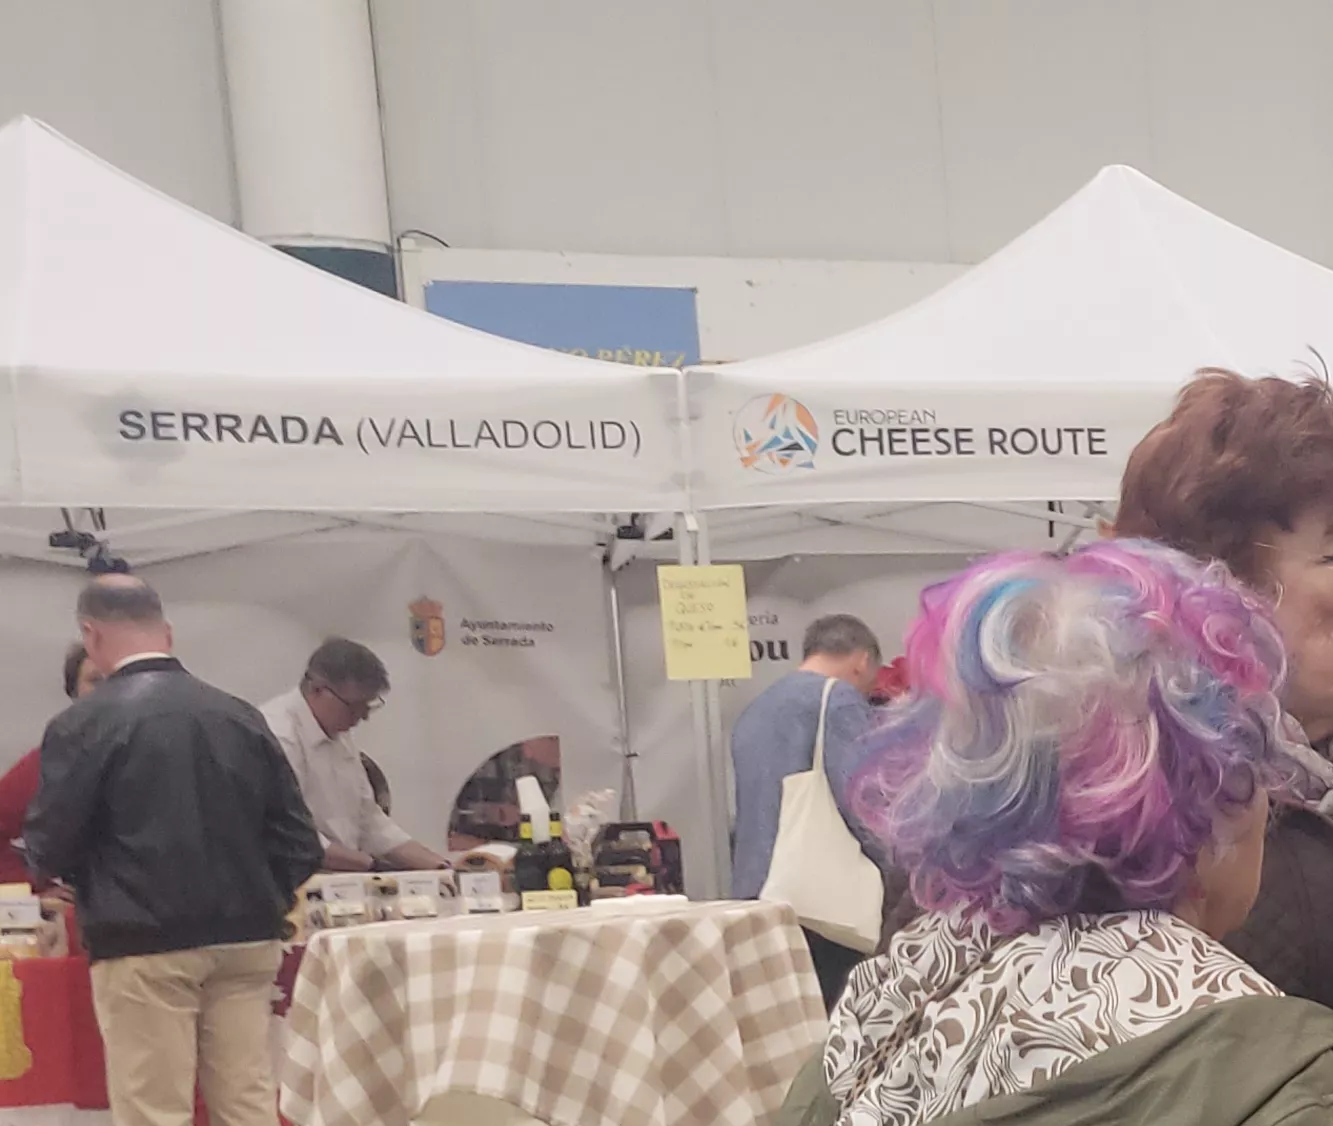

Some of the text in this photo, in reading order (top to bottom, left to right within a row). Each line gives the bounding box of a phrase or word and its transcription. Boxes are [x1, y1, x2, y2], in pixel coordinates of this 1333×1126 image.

[833, 408, 936, 425] EUROPEAN
[118, 409, 642, 457] SERRADA (VALLADOLID)
[831, 427, 1108, 457] CHEESE ROUTE
[750, 639, 790, 662] ou
